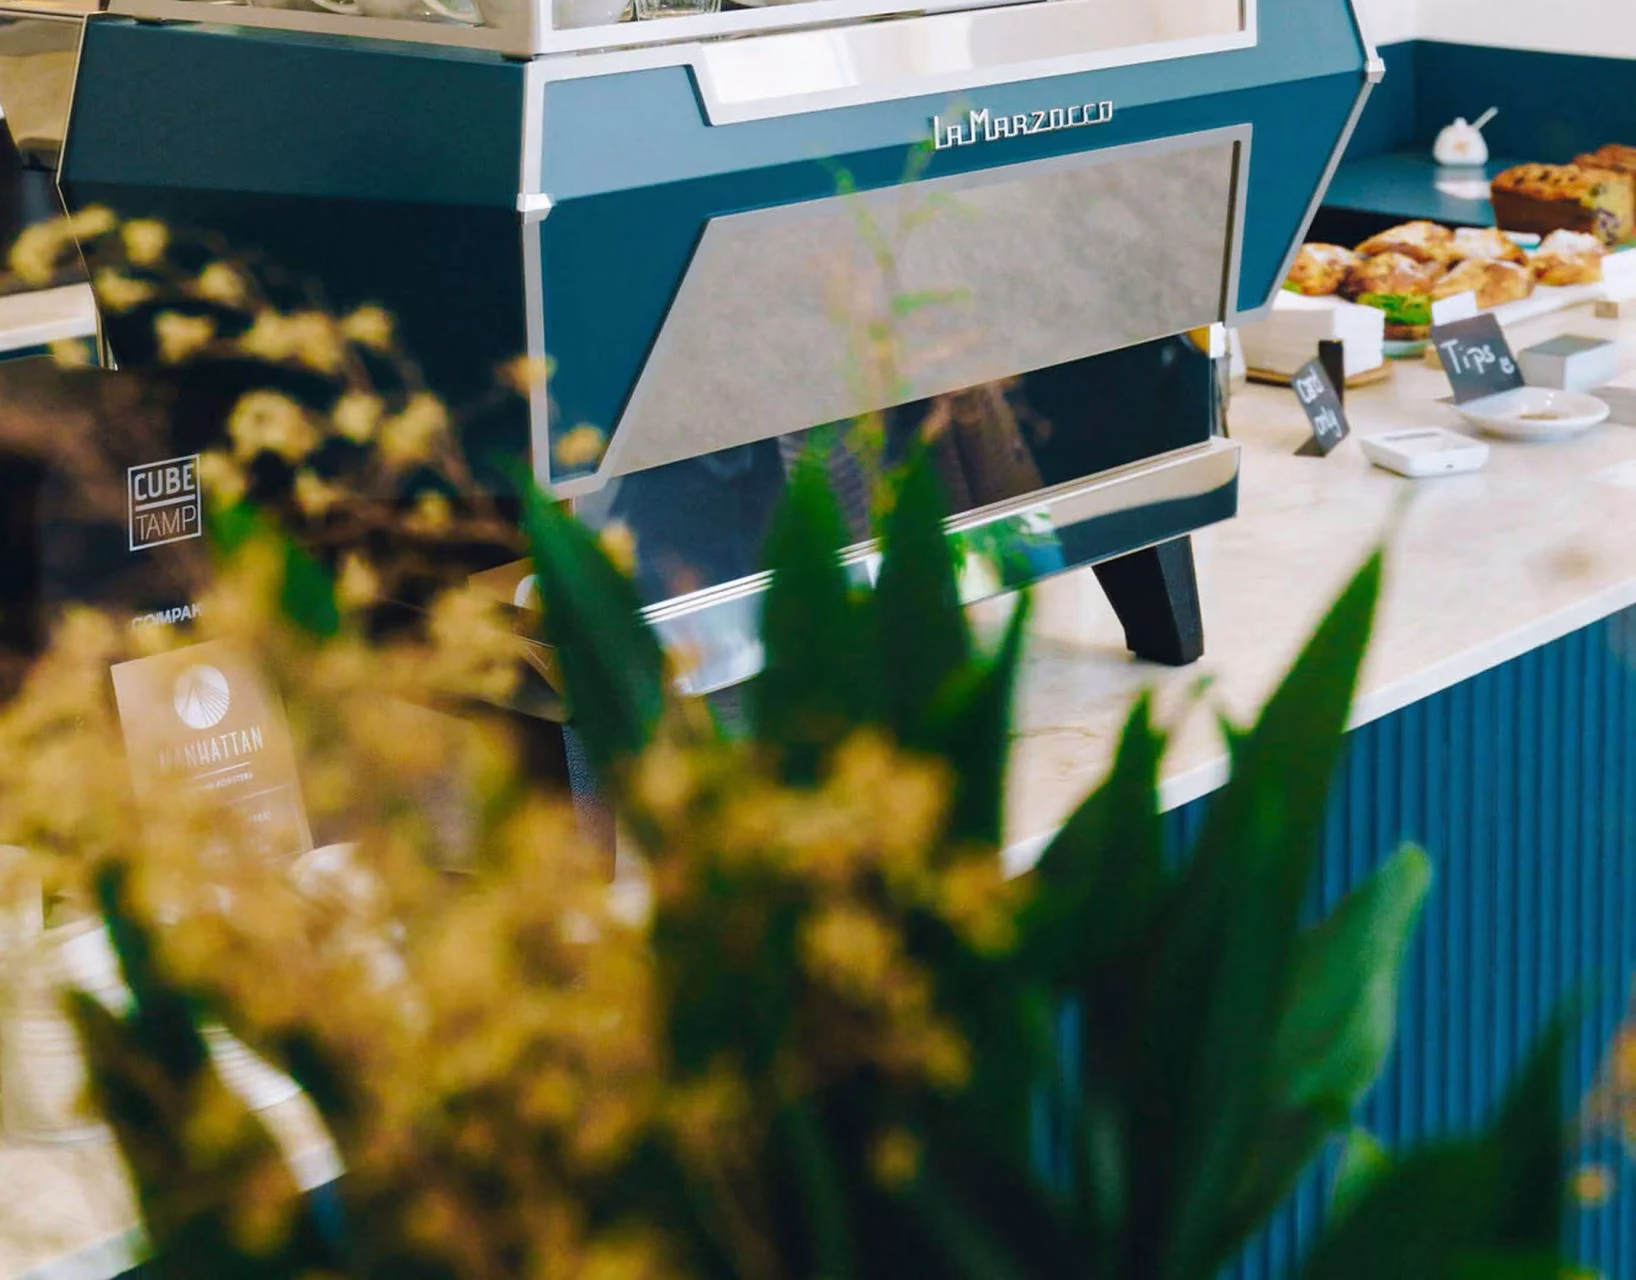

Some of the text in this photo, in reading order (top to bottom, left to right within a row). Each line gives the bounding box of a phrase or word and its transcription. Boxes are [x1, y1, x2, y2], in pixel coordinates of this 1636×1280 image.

[1440, 338, 1497, 375] Tips
[133, 463, 196, 502] CUBE
[135, 504, 197, 541] TAMP
[158, 726, 264, 771] NHATTAN
